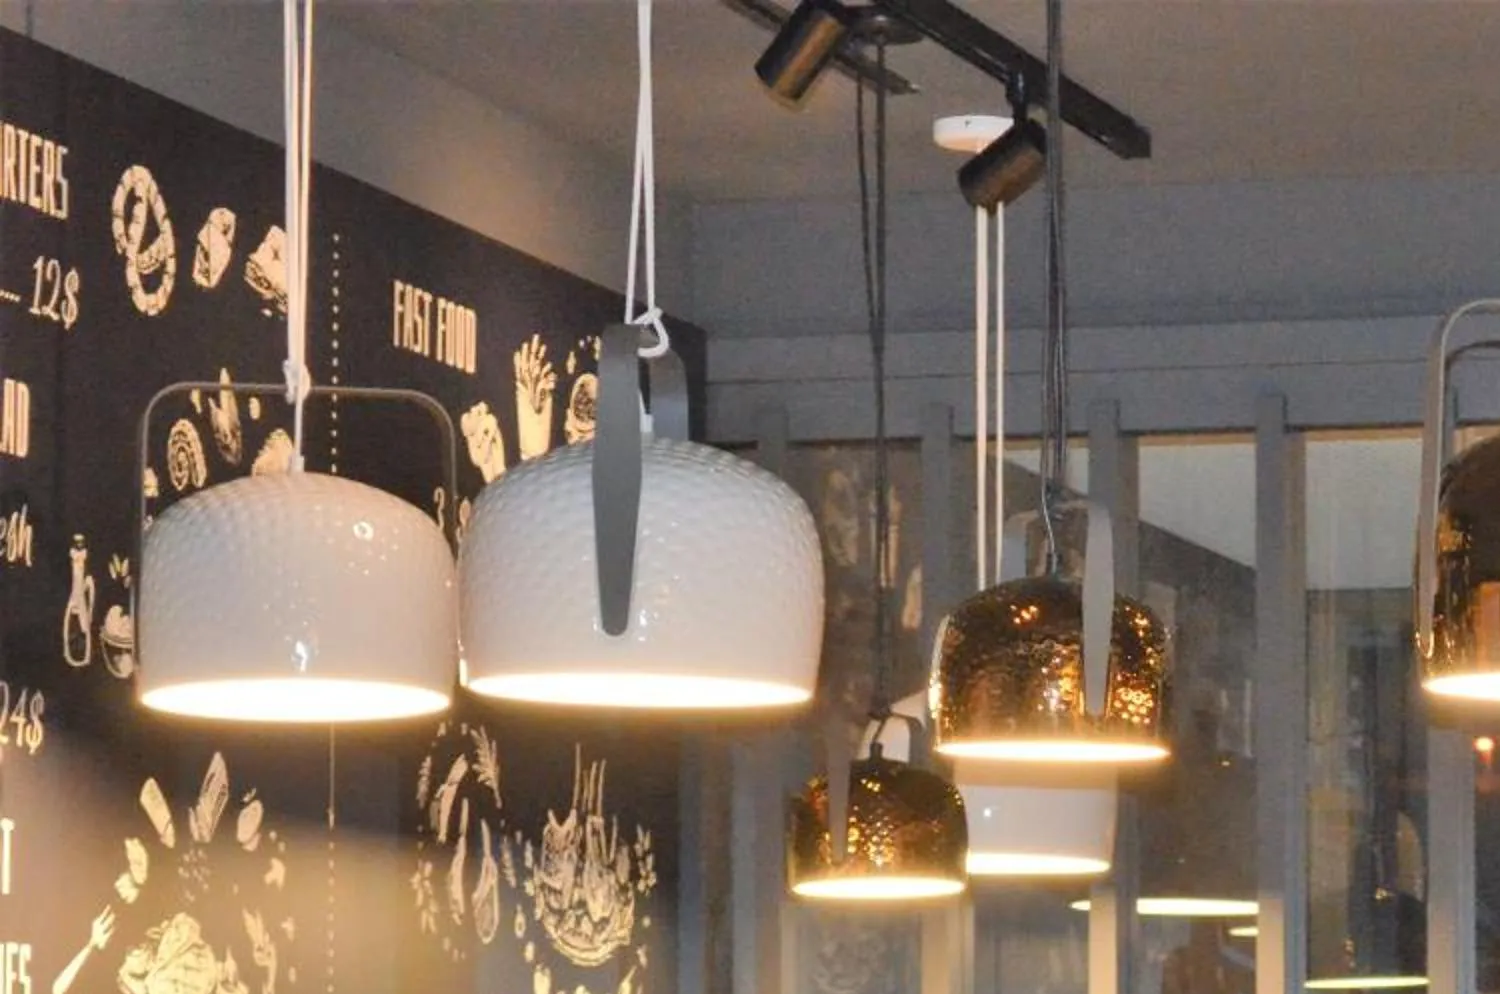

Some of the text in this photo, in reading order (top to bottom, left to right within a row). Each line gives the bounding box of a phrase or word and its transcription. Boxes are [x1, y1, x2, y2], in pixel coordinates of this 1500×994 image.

[0, 119, 68, 220] RTERS
[28, 255, 80, 330] 12$
[393, 280, 477, 374] FAST FOOD
